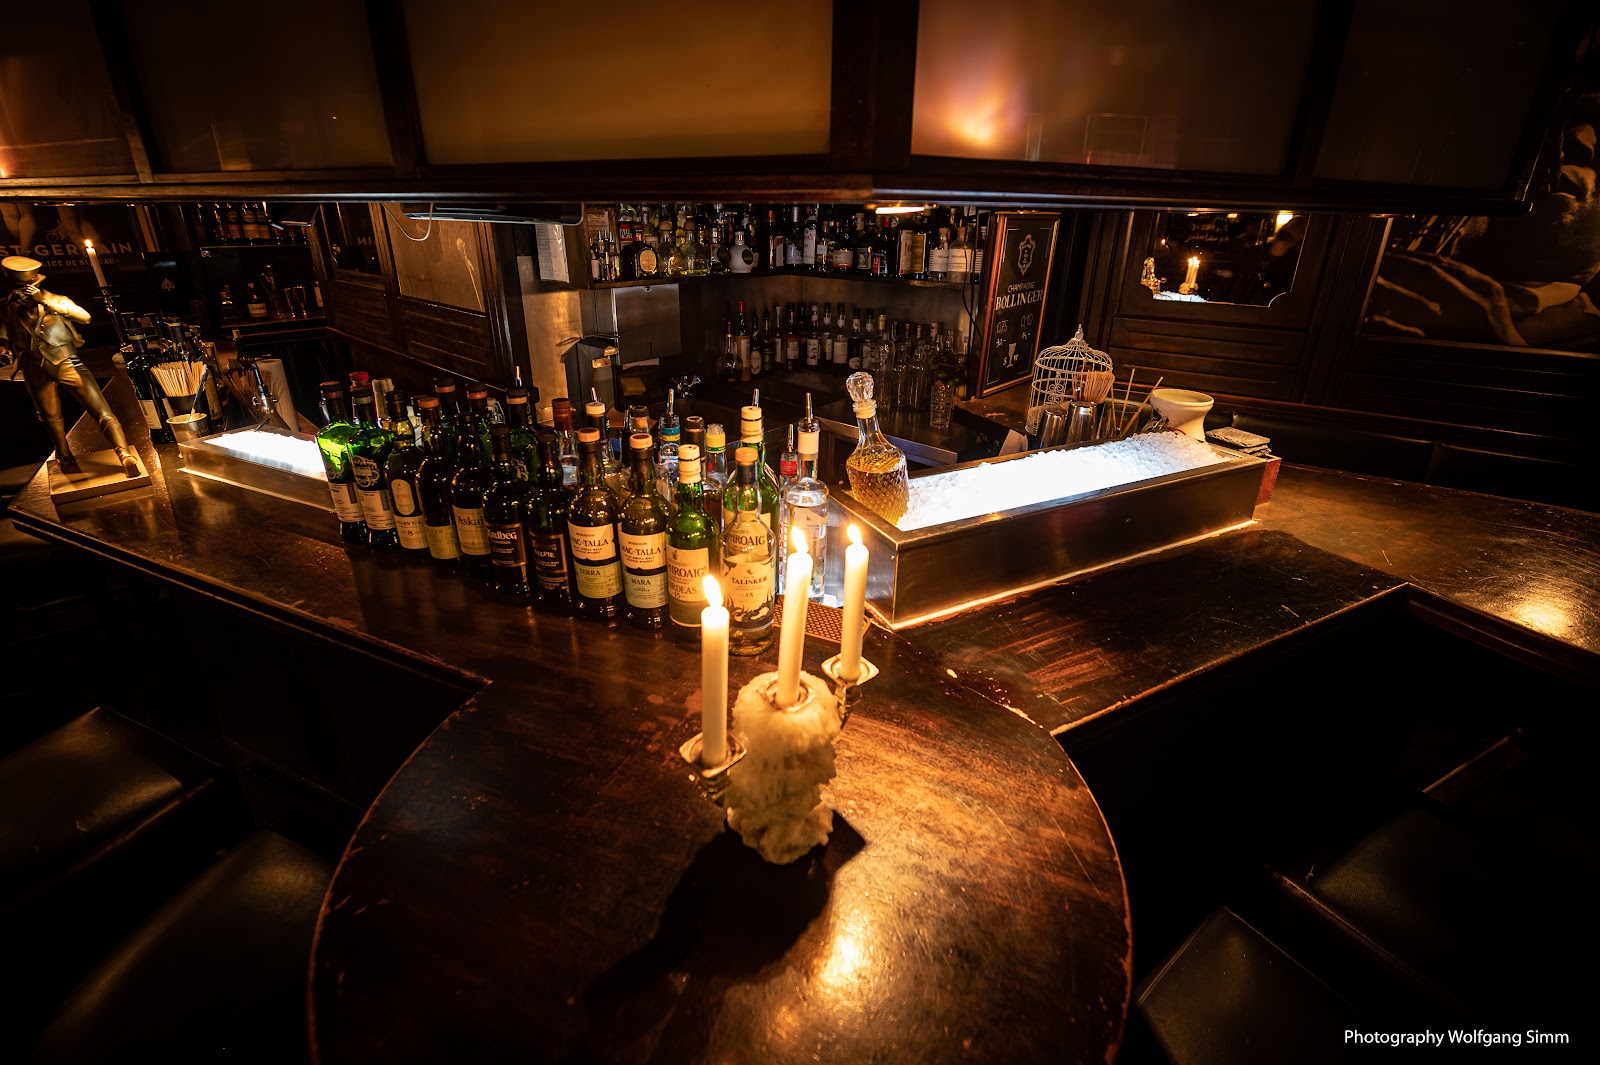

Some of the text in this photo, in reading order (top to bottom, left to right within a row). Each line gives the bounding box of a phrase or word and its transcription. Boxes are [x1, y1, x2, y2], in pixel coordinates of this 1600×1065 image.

[0, 242, 132, 257] ST-GERAIN
[42, 258, 65, 267] LICE
[80, 258, 115, 266] SUEAU
[1008, 281, 1035, 292] CHAMPAGNE
[995, 290, 1043, 310] BOLLINGER
[458, 515, 484, 526] Askai
[407, 529, 414, 537] 8
[580, 568, 601, 576] TERRA
[731, 576, 768, 585] TALISKER
